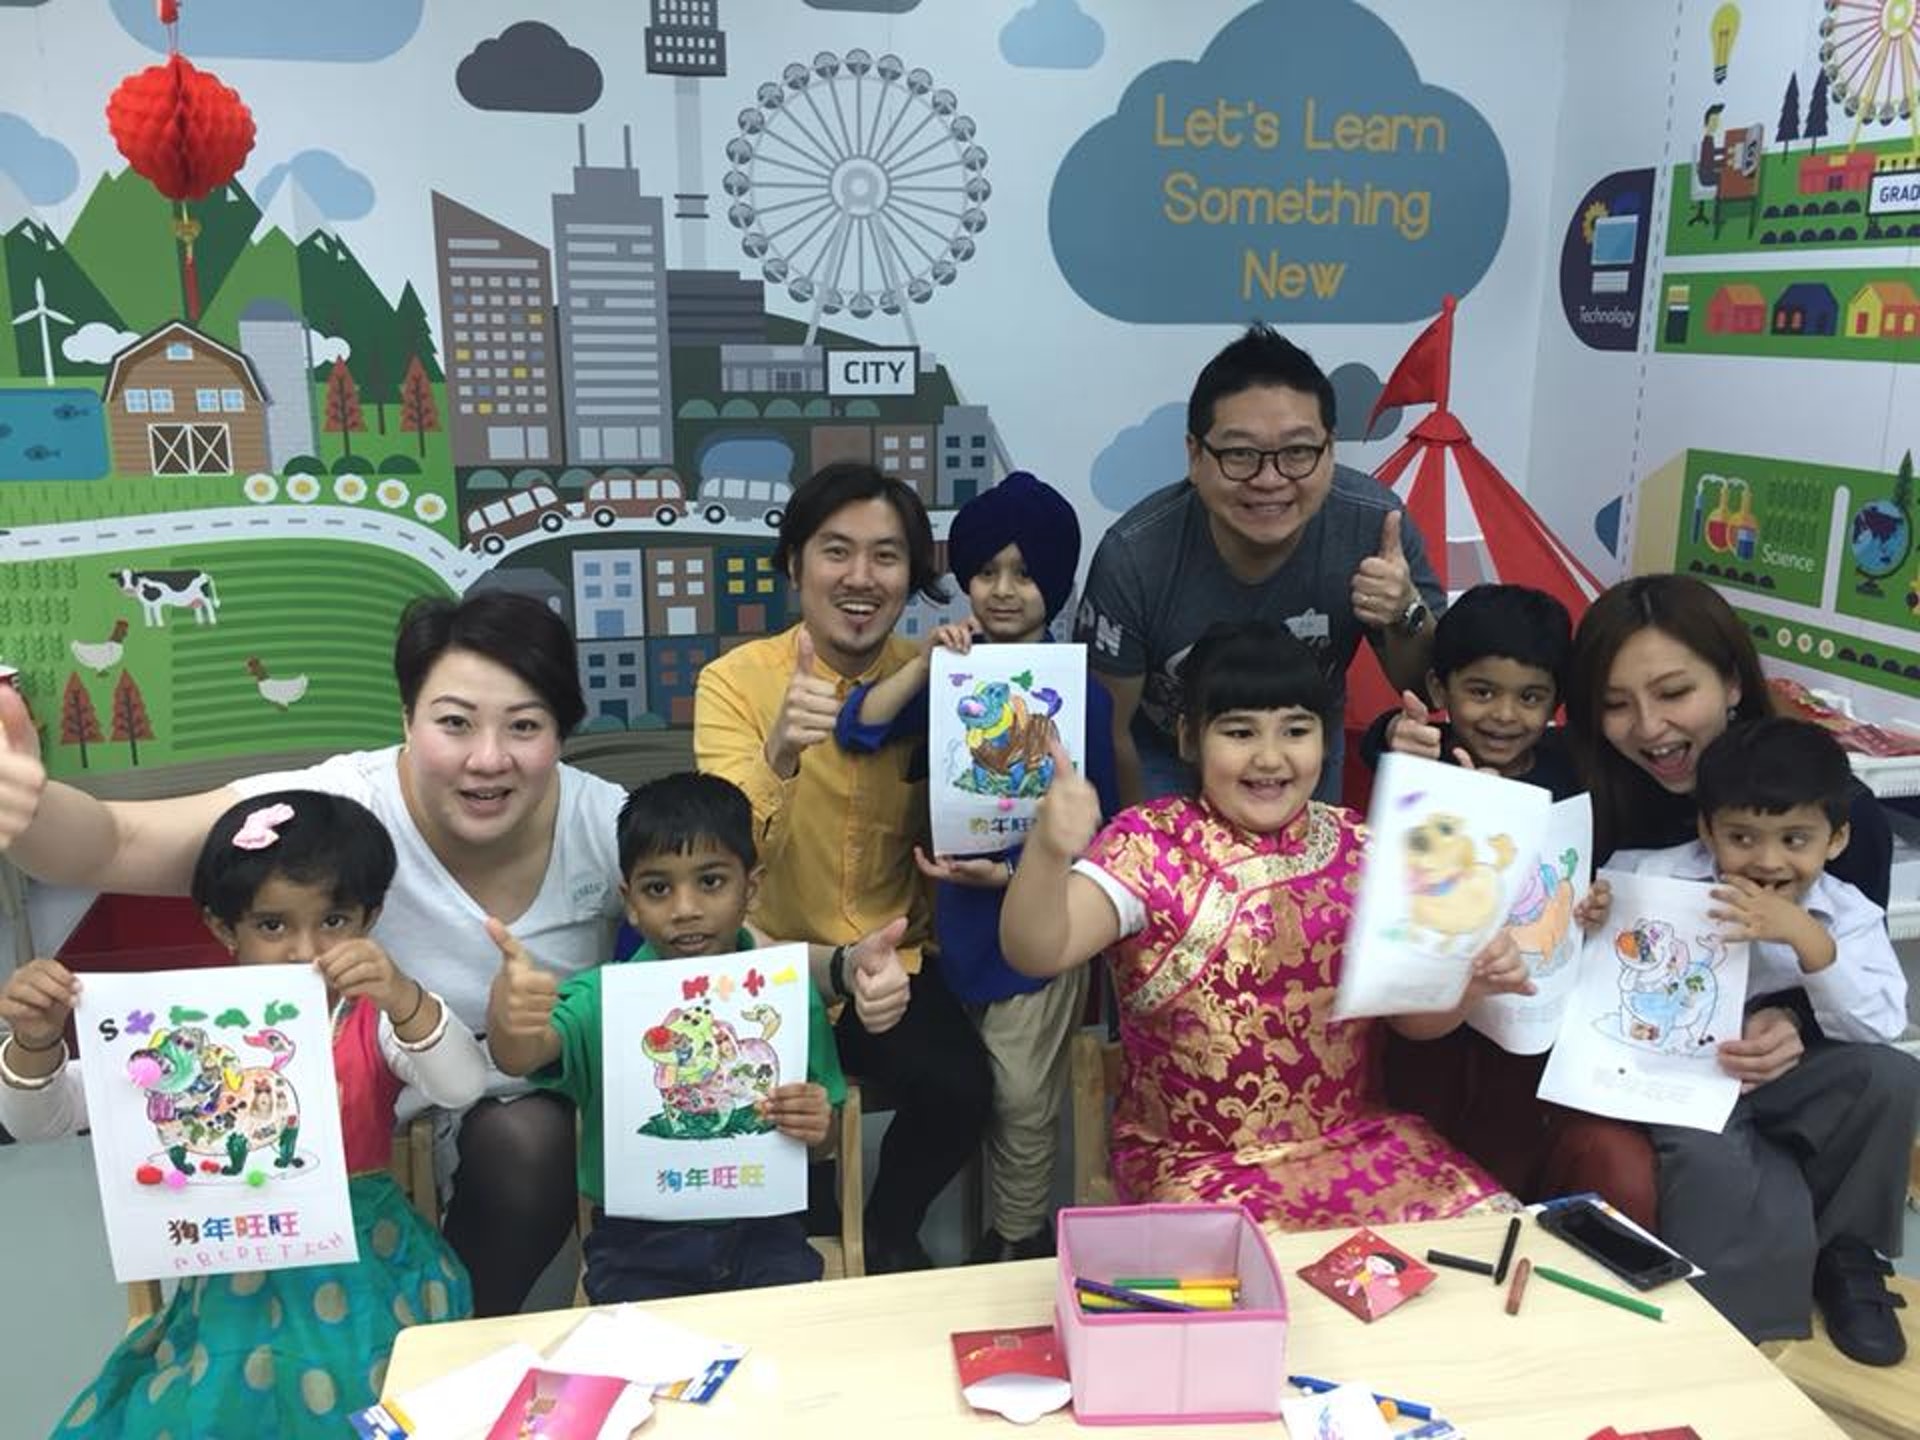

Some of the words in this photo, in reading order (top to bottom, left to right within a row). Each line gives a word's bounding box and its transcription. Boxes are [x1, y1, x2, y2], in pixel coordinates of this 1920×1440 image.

[1154, 93, 1281, 149] Let's
[1305, 97, 1448, 152] Learn
[1162, 169, 1433, 242] Something
[1240, 247, 1348, 302] New
[1579, 304, 1636, 329] Technology
[844, 361, 905, 384] CITY
[1761, 543, 1816, 573] Science
[656, 1164, 765, 1193] 狗年旺旺
[167, 1211, 300, 1246] 狗年旺旺
